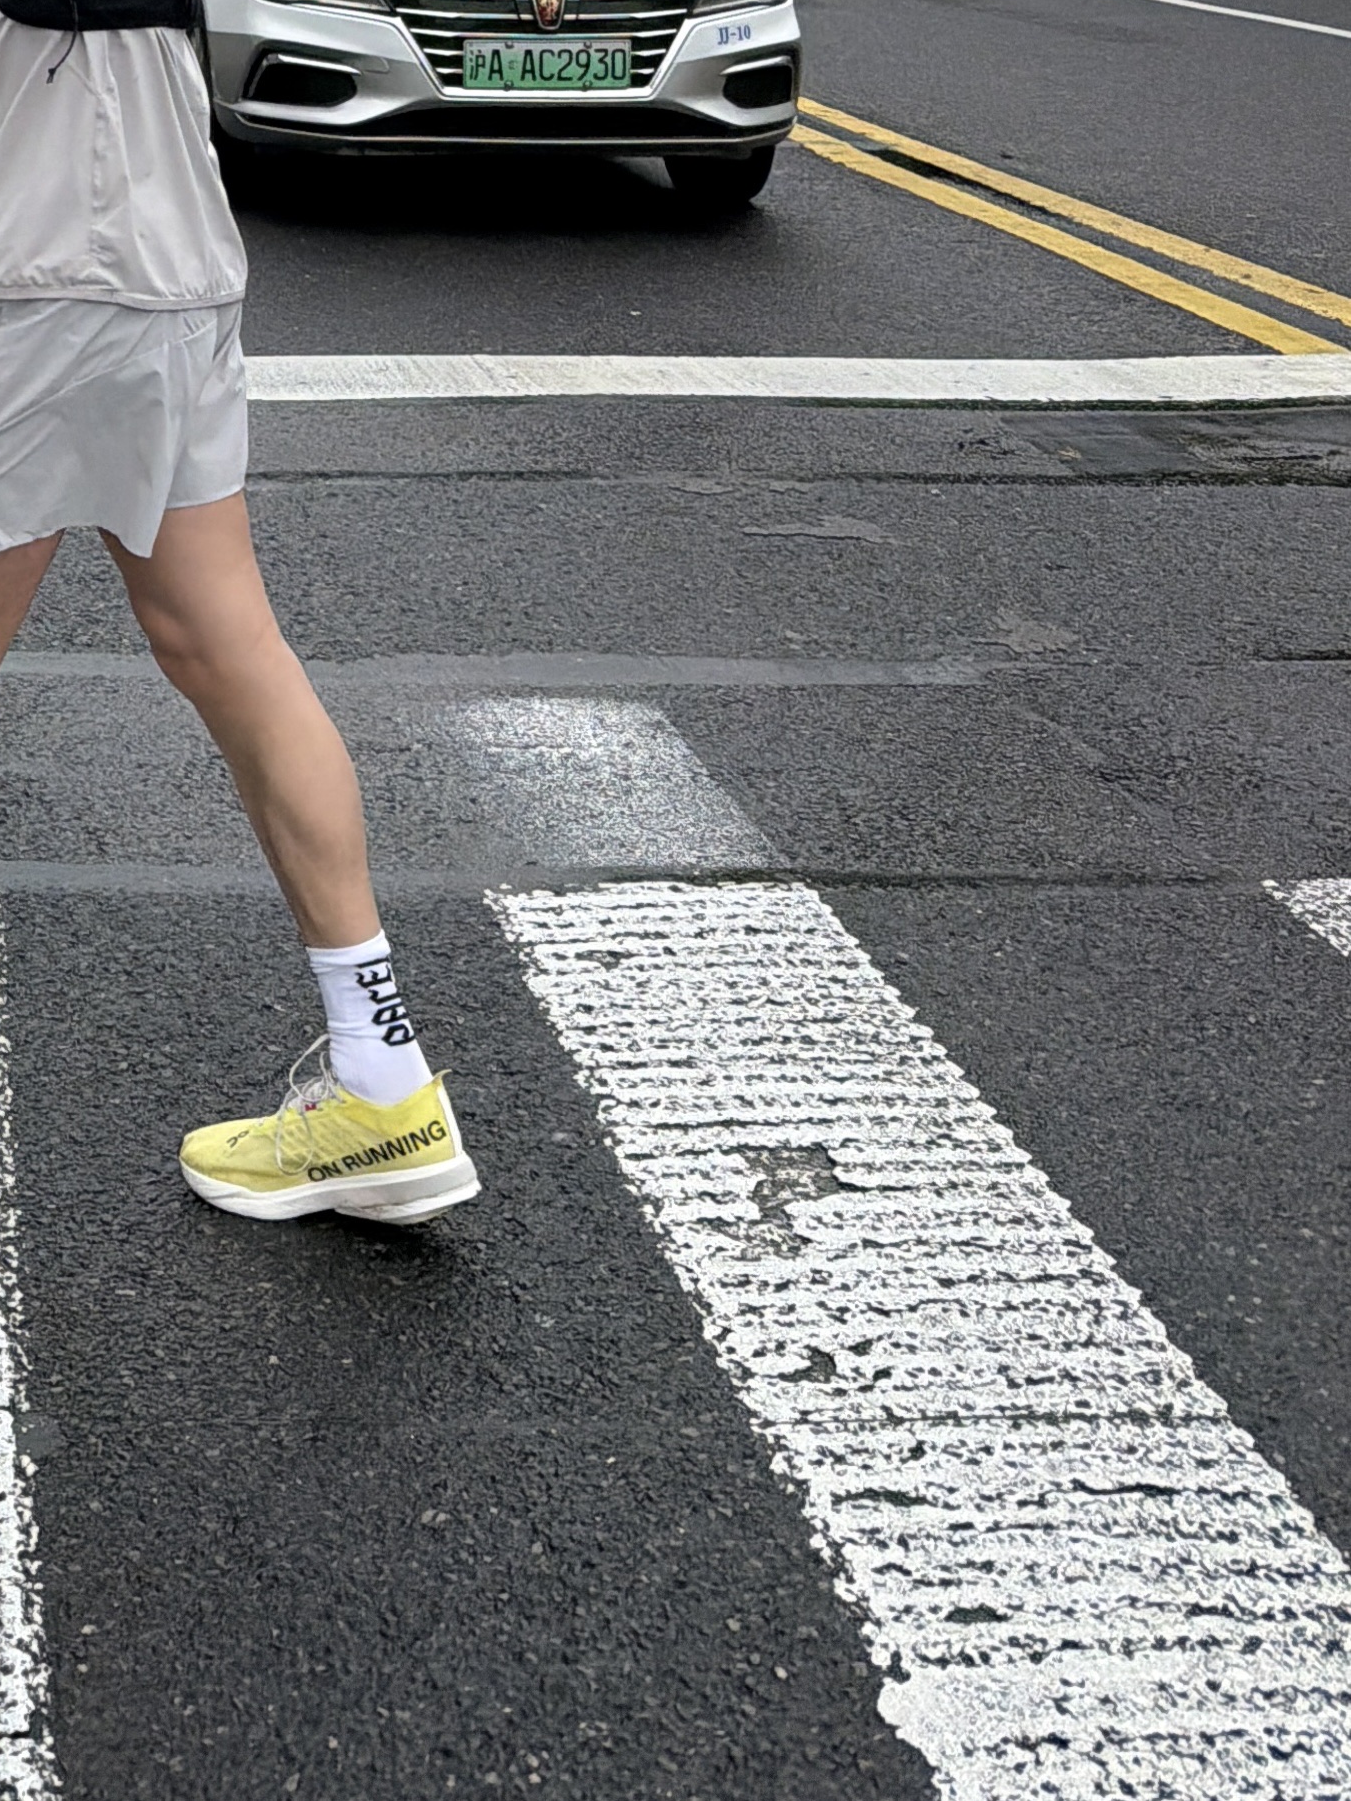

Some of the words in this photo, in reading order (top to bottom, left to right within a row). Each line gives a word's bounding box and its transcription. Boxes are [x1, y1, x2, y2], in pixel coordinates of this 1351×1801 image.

[520, 49, 628, 81] AC2930
[307, 1161, 343, 1182] ON
[341, 1120, 447, 1172] RUNNING
